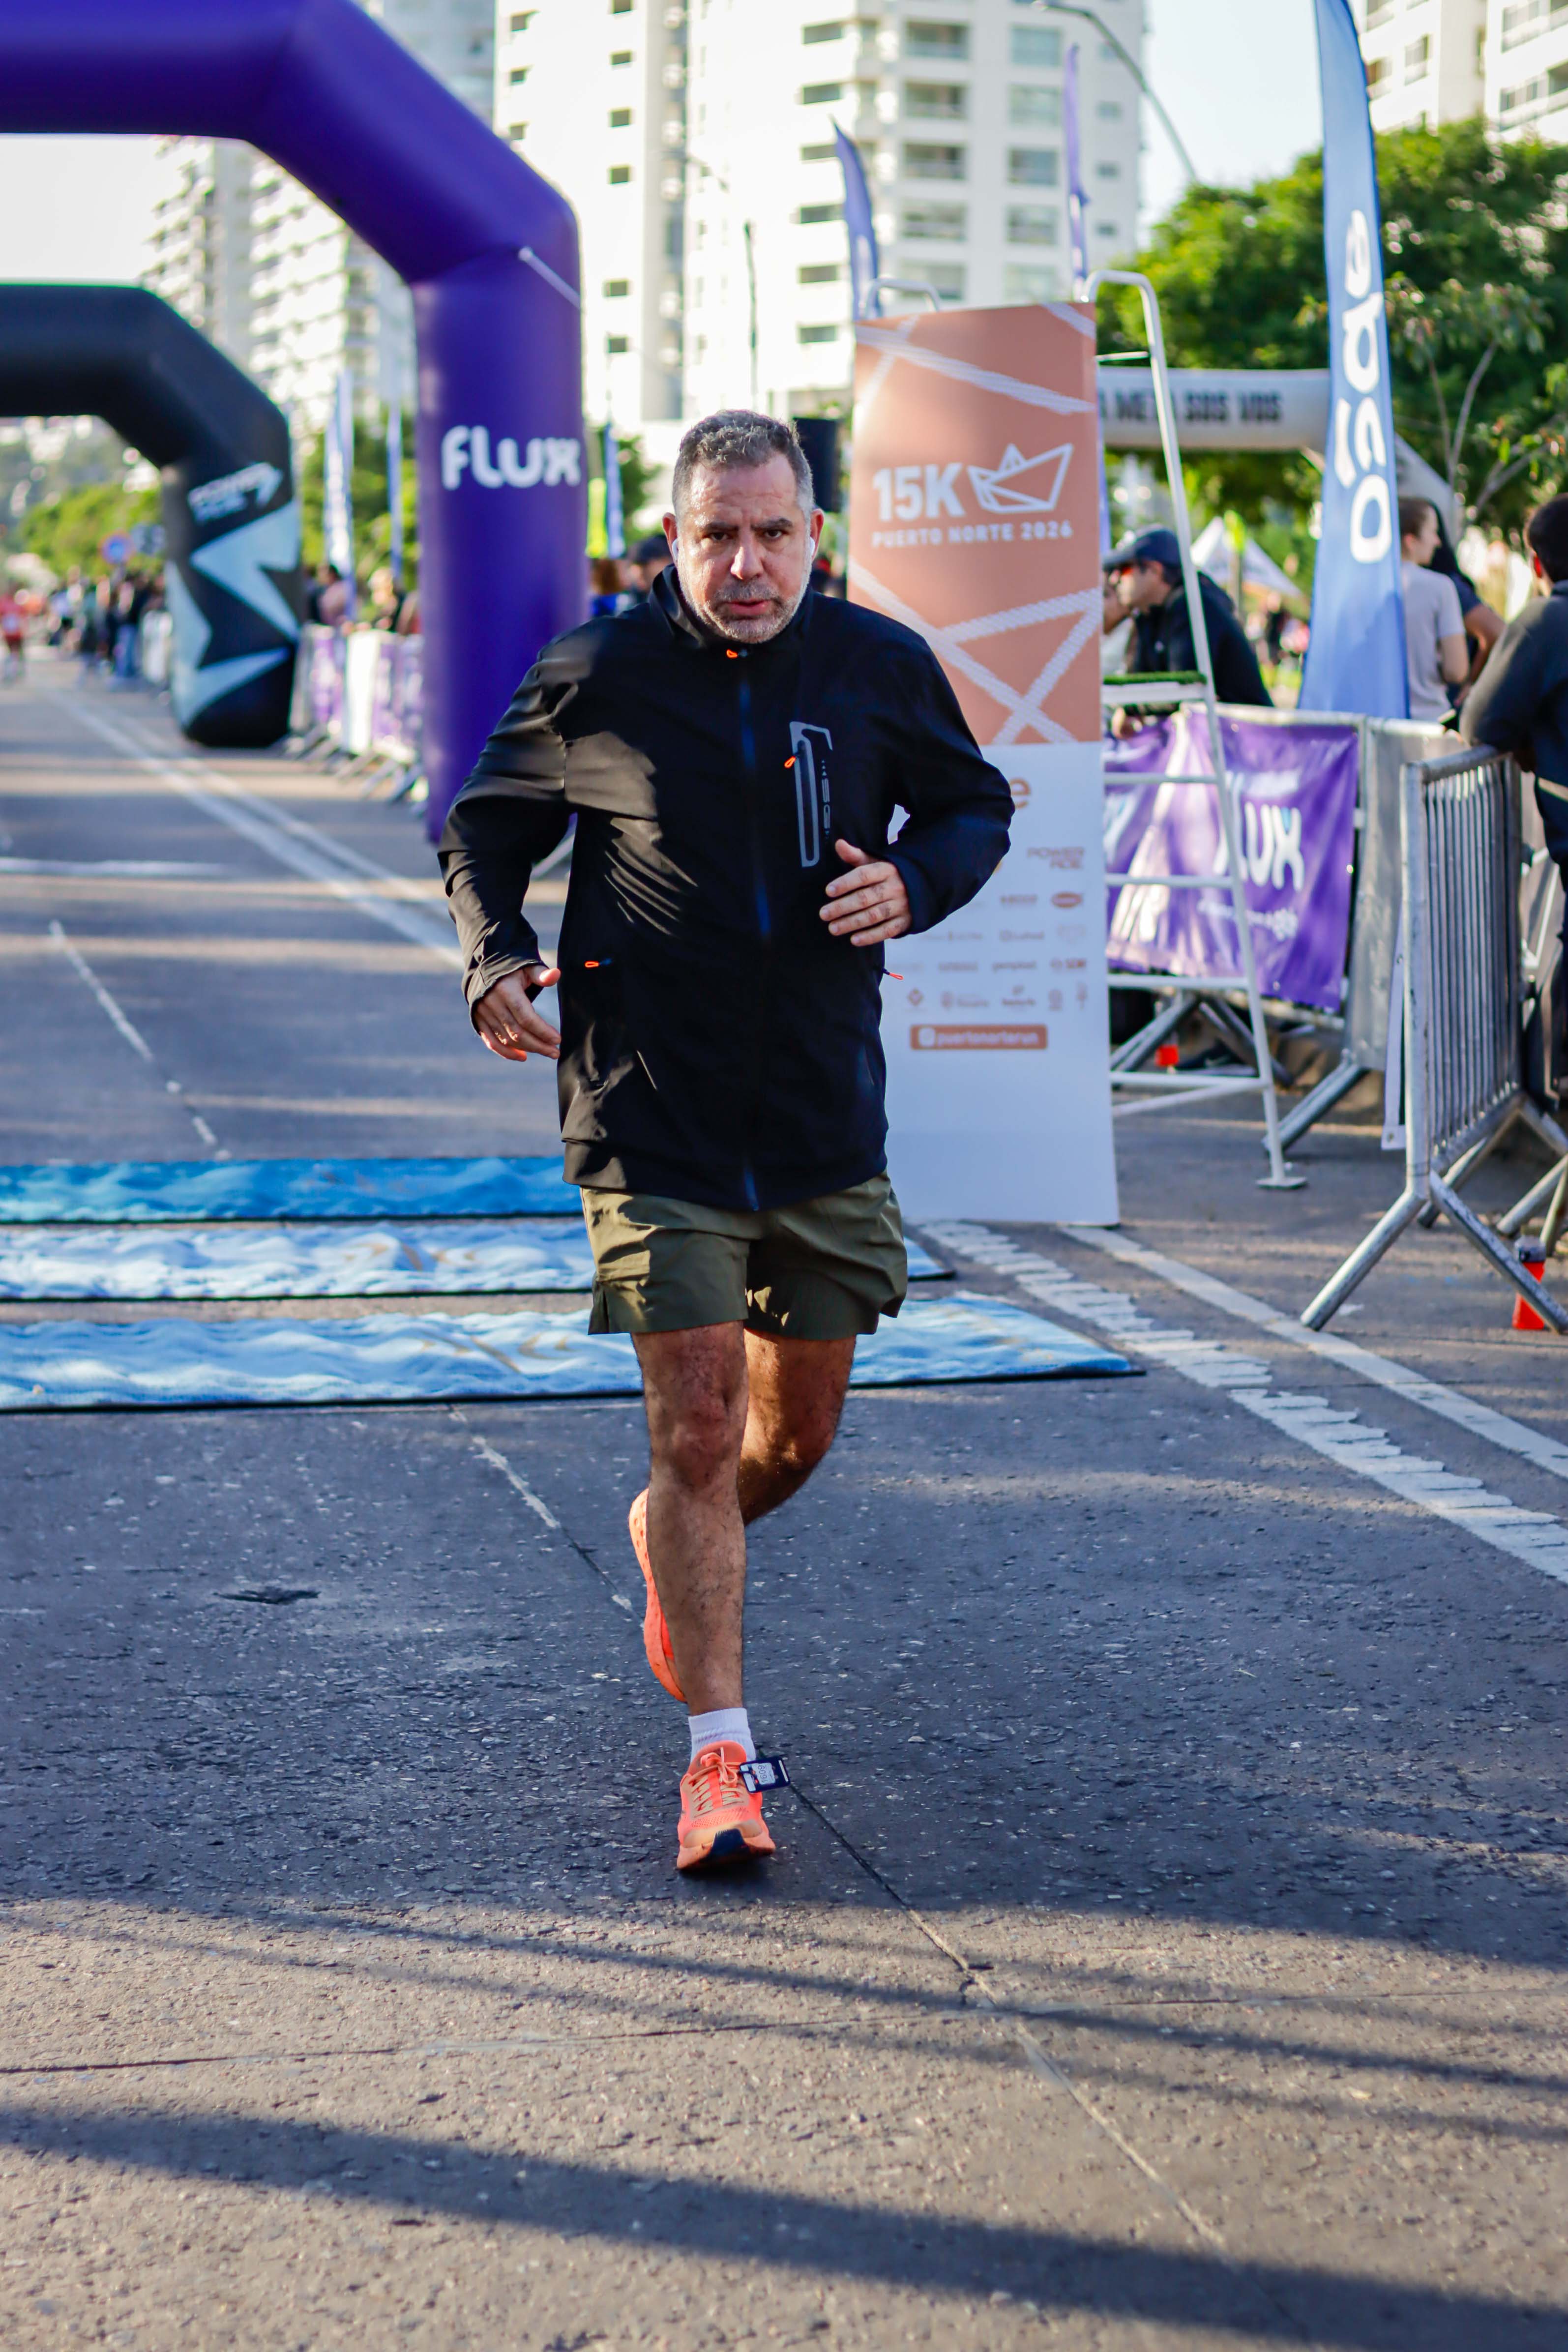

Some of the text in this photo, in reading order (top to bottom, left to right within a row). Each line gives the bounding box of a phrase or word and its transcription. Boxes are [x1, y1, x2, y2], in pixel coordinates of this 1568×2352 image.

[1185, 390, 1228, 422] SOS
[873, 462, 965, 521] 15K
[872, 520, 1073, 548] PUERTO NORTE 2026
[758, 1765, 768, 1783] 1609
